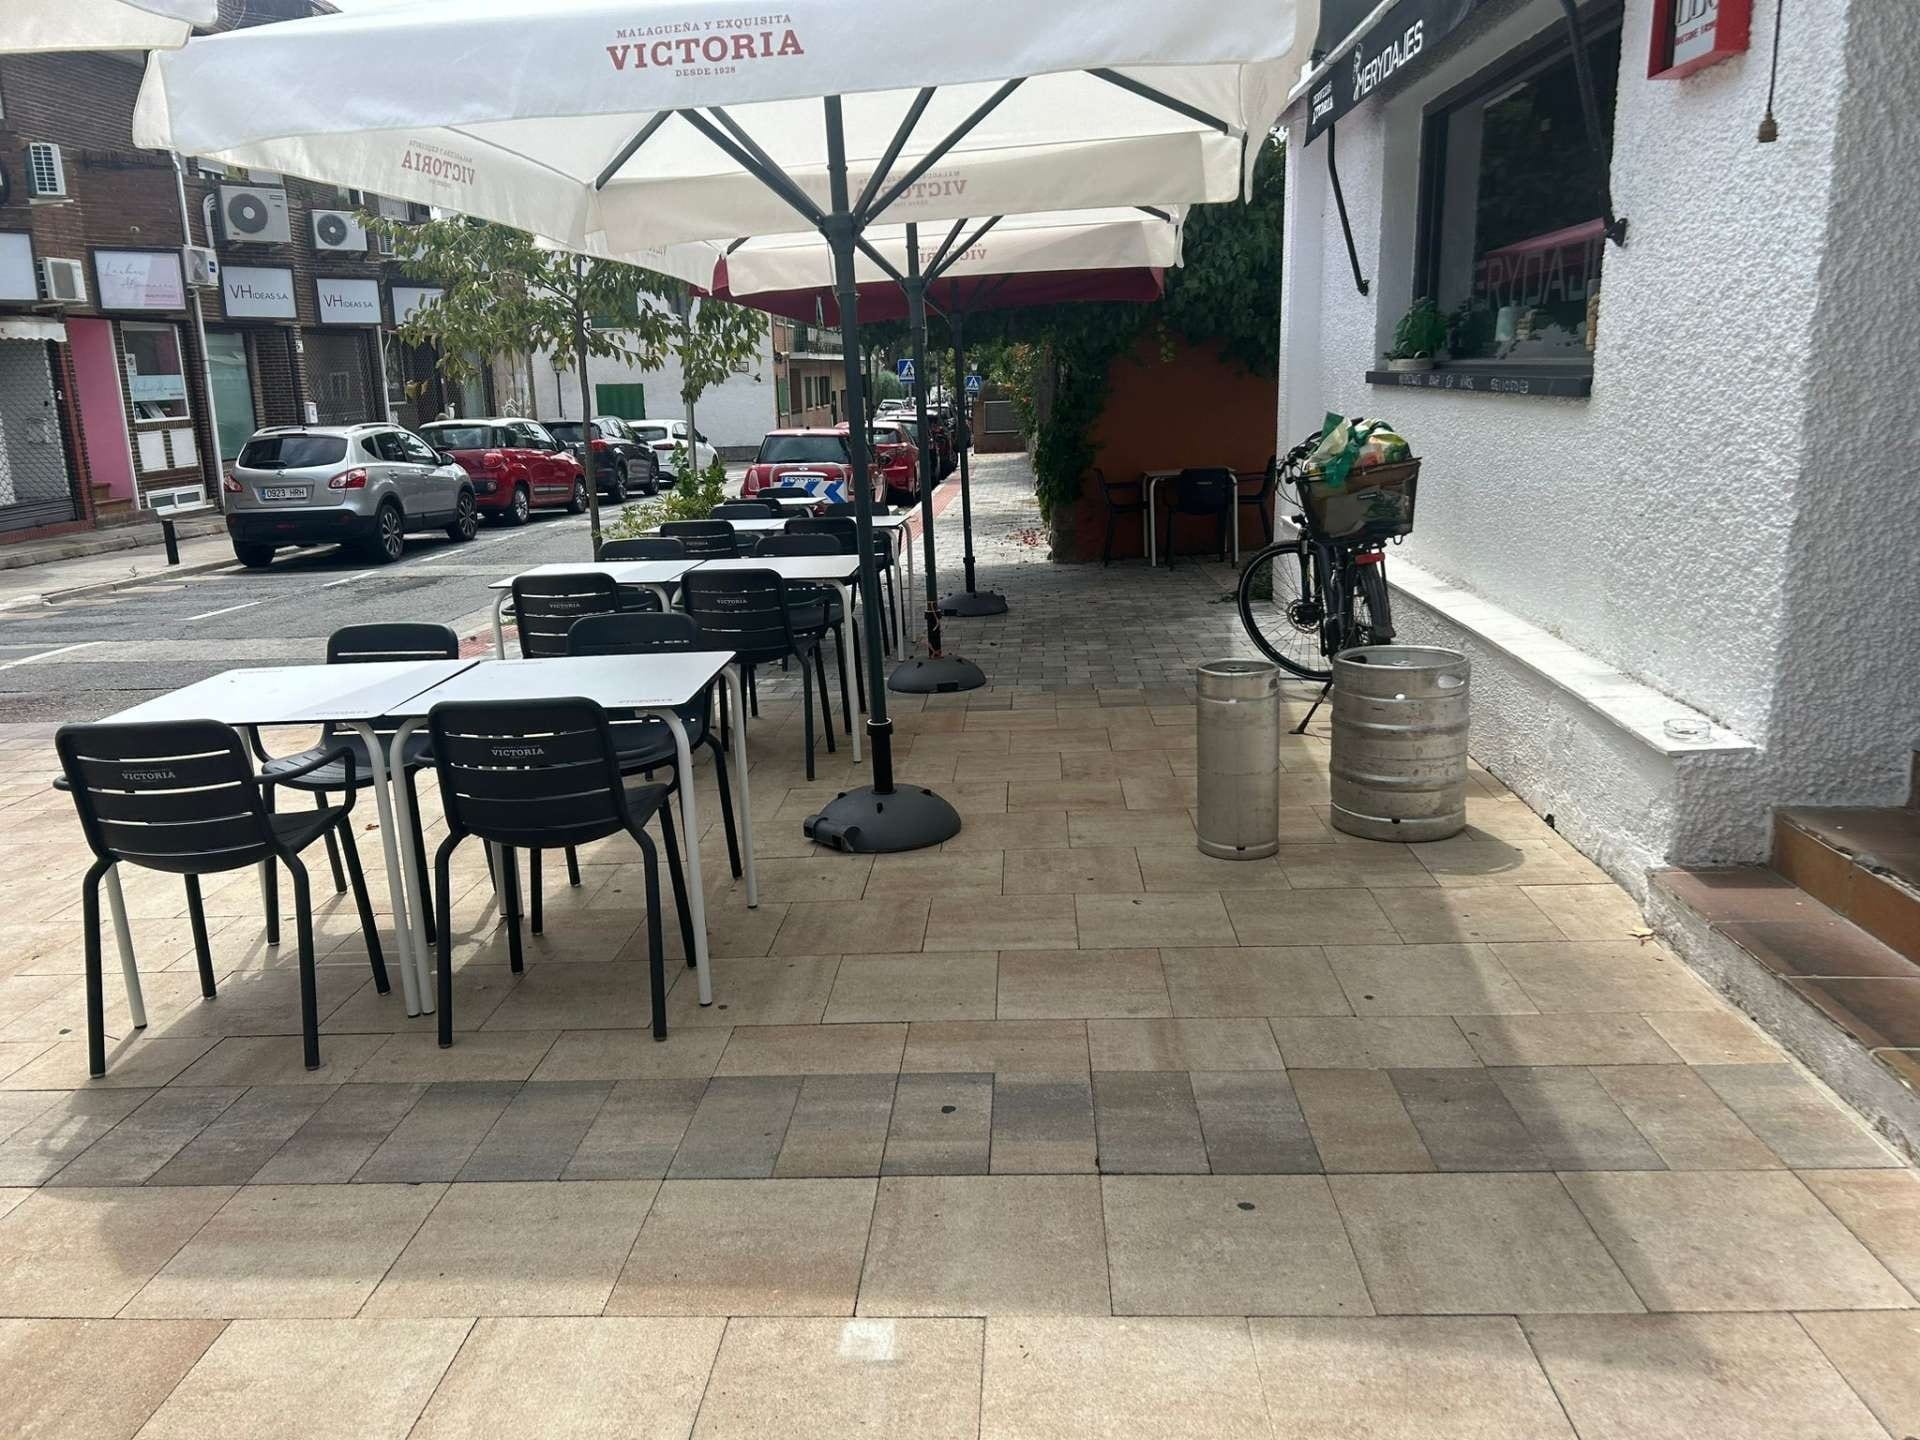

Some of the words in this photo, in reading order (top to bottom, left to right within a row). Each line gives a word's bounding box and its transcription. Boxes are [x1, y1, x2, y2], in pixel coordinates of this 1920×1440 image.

[617, 22, 700, 39] MALAGUEÑA
[704, 21, 712, 32] Y
[716, 14, 792, 30] EXQUISITA
[607, 29, 804, 71] VICTORIA
[1353, 19, 1425, 101] MERYDAJES
[676, 68, 711, 77] DESDE
[491, 748, 544, 757] VICTORIA
[121, 771, 176, 781] VICTORIA
